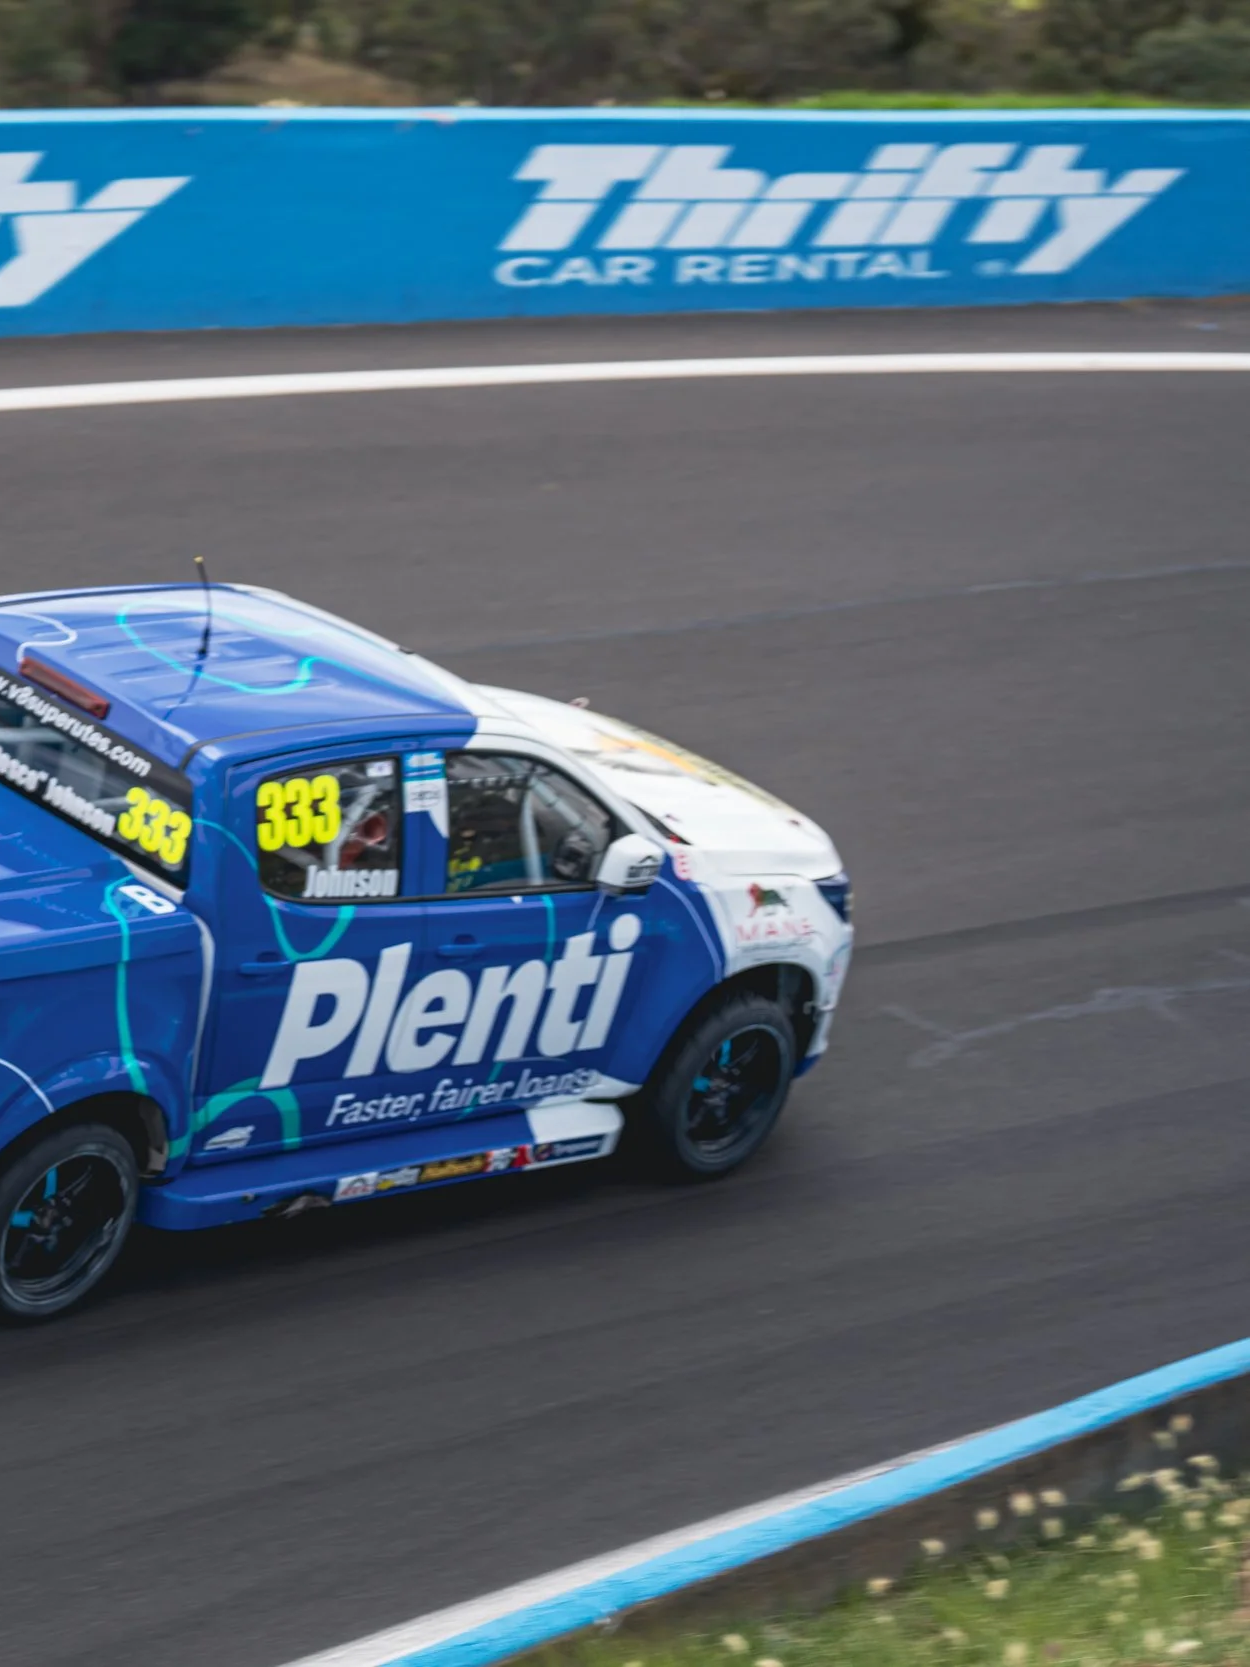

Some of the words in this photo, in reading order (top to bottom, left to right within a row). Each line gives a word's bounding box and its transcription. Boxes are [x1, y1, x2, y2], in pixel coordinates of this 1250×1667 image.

[497, 142, 1187, 274] Thrifty
[491, 256, 655, 287] CAR
[674, 251, 950, 286] RENTAL
[43, 777, 117, 836] Johnson
[118, 787, 192, 865] 333
[257, 775, 341, 852] 333
[302, 865, 398, 899] Johnson
[259, 913, 641, 1089] Plenti
[325, 1093, 425, 1127] Faster,
[428, 1078, 514, 1113] fairer
